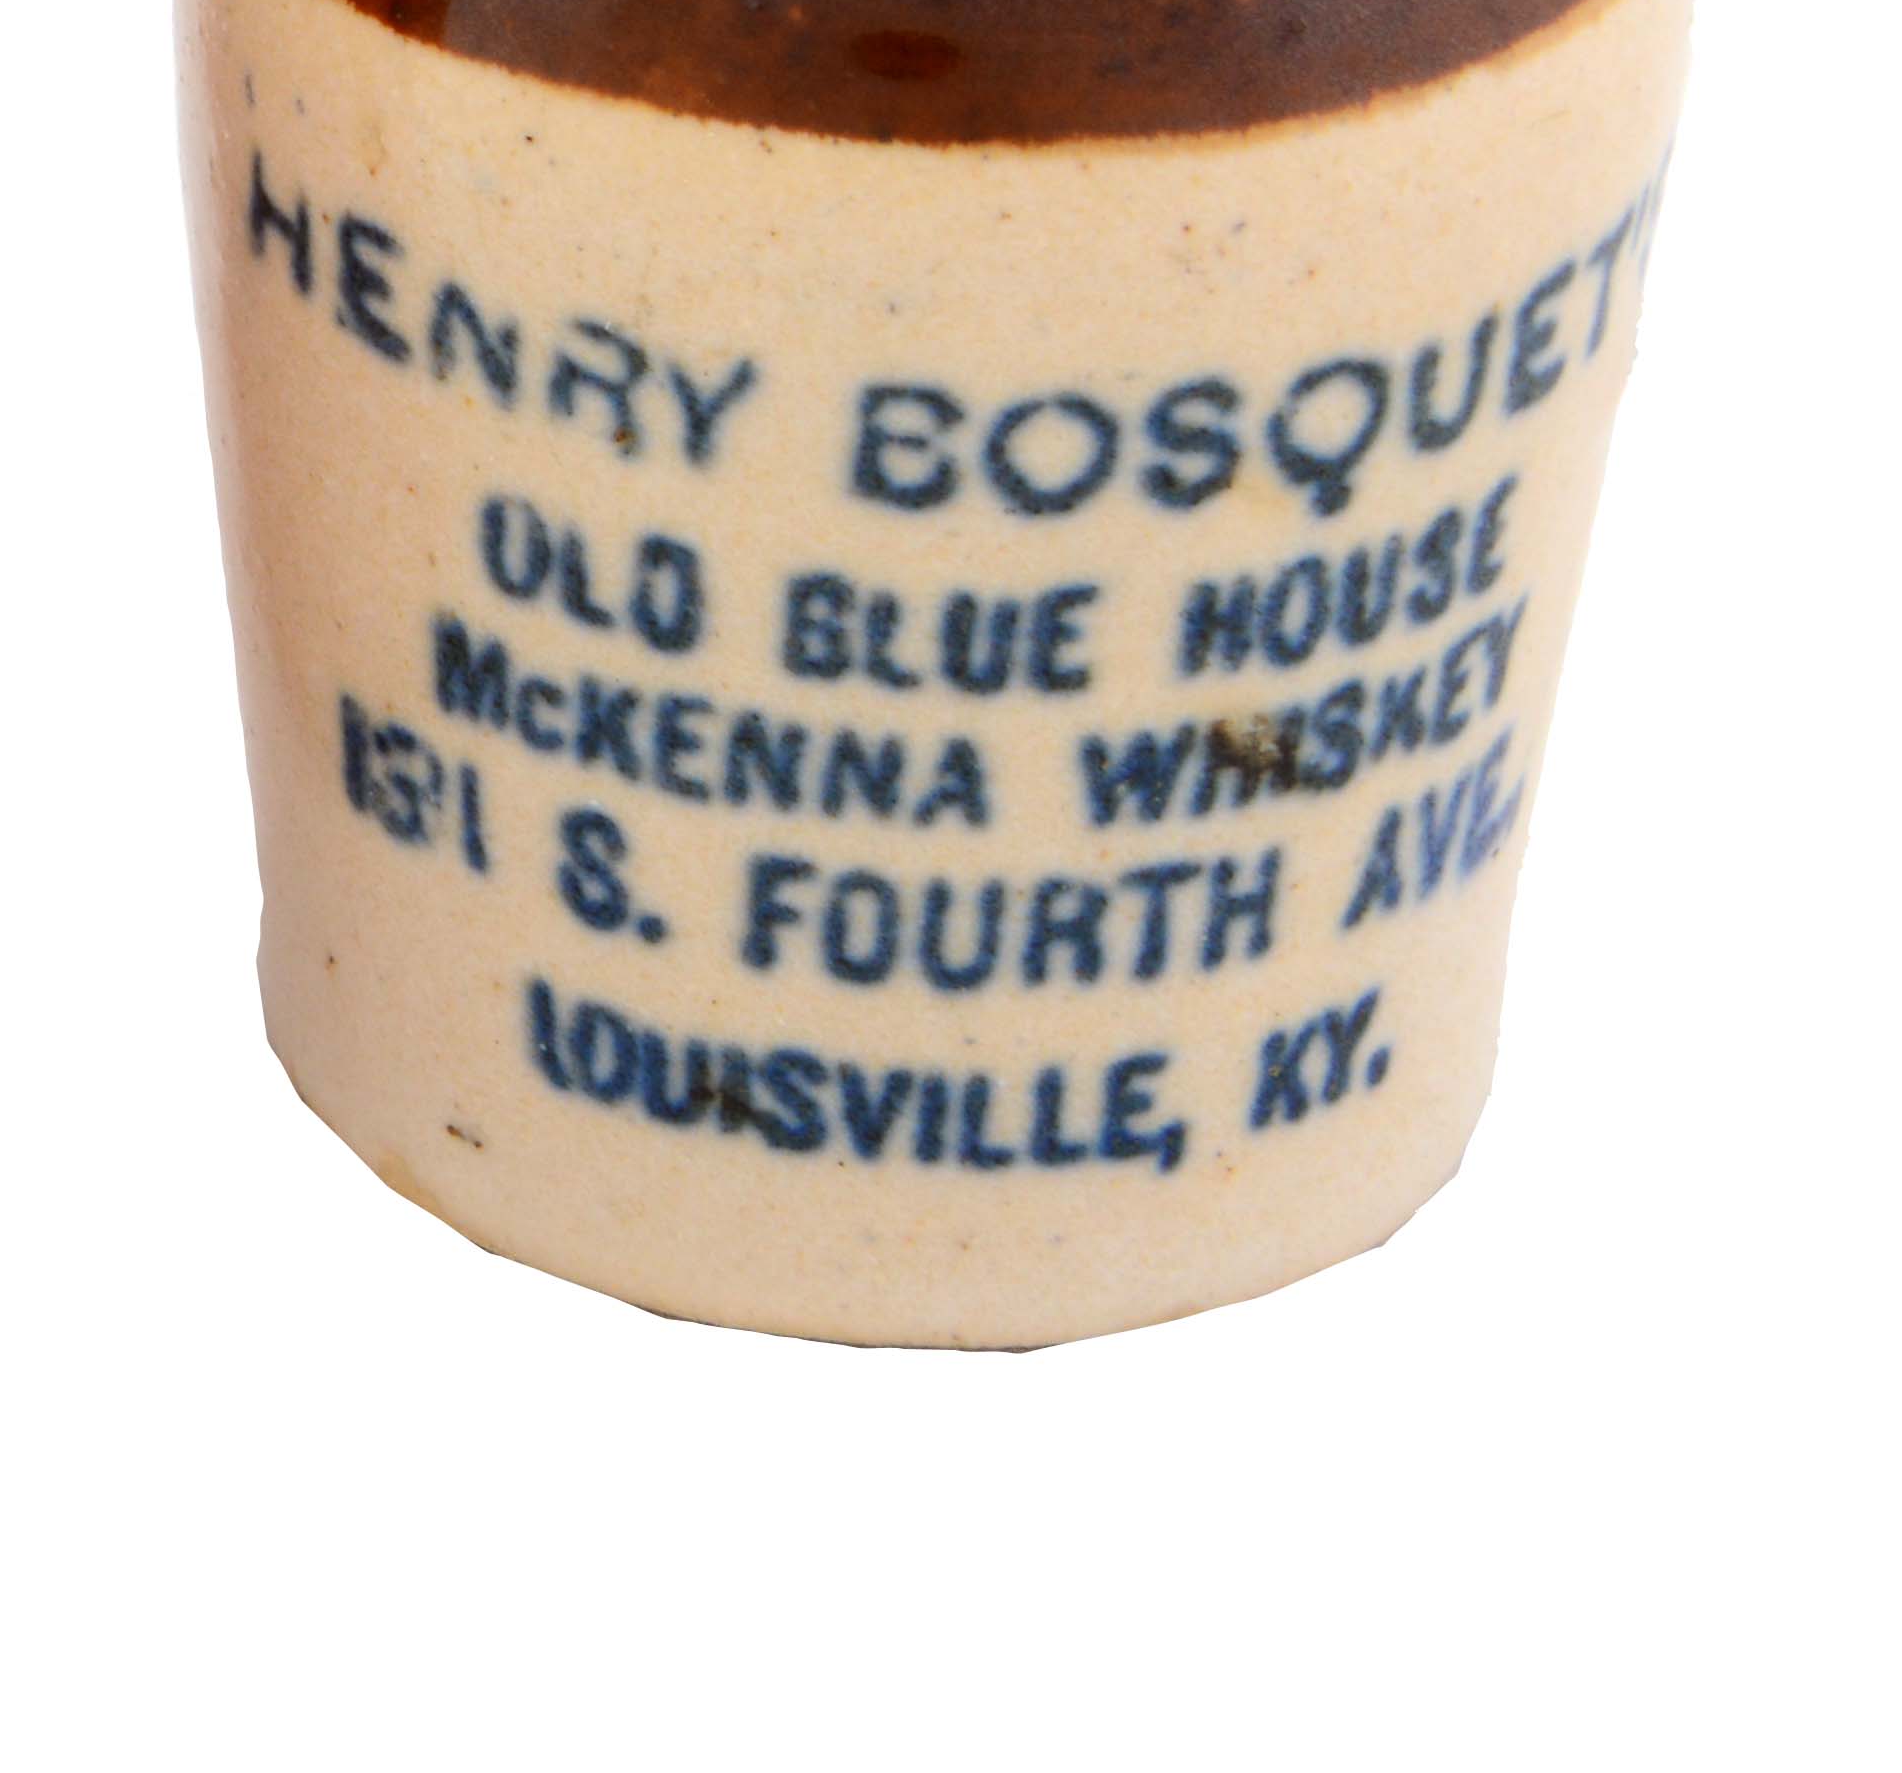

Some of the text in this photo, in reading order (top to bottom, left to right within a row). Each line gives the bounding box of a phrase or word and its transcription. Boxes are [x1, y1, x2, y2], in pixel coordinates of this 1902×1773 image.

[249, 149, 757, 462] HENRY
[479, 474, 1523, 694] OLD BLUE HOUSE
[432, 592, 1529, 829] McKENNA WHISKEY
[556, 803, 669, 944] S.
[741, 846, 1281, 994] FOURTH
[525, 975, 1392, 1173] LOUISVILLE, KY.
